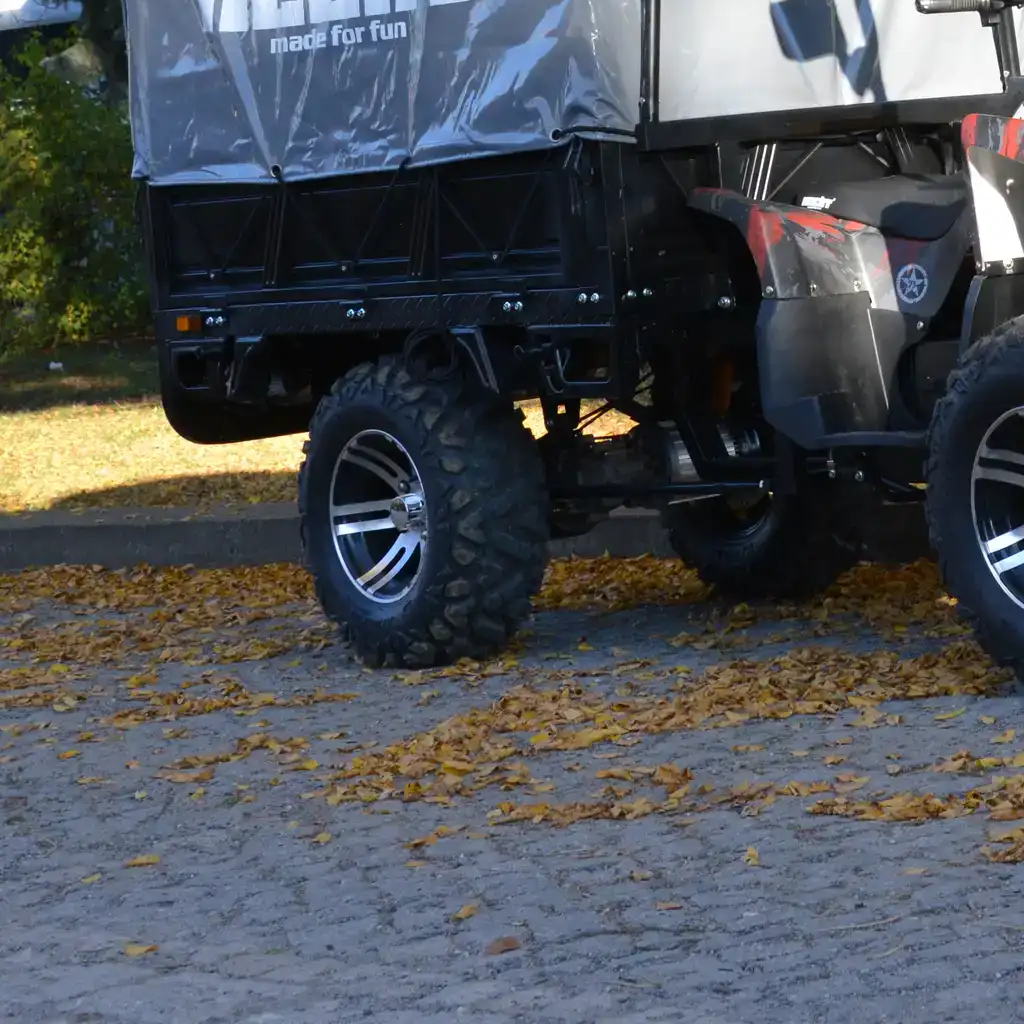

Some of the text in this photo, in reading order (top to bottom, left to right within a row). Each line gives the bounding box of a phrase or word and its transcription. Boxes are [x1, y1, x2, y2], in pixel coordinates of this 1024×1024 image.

[270, 20, 407, 54] made for fun
